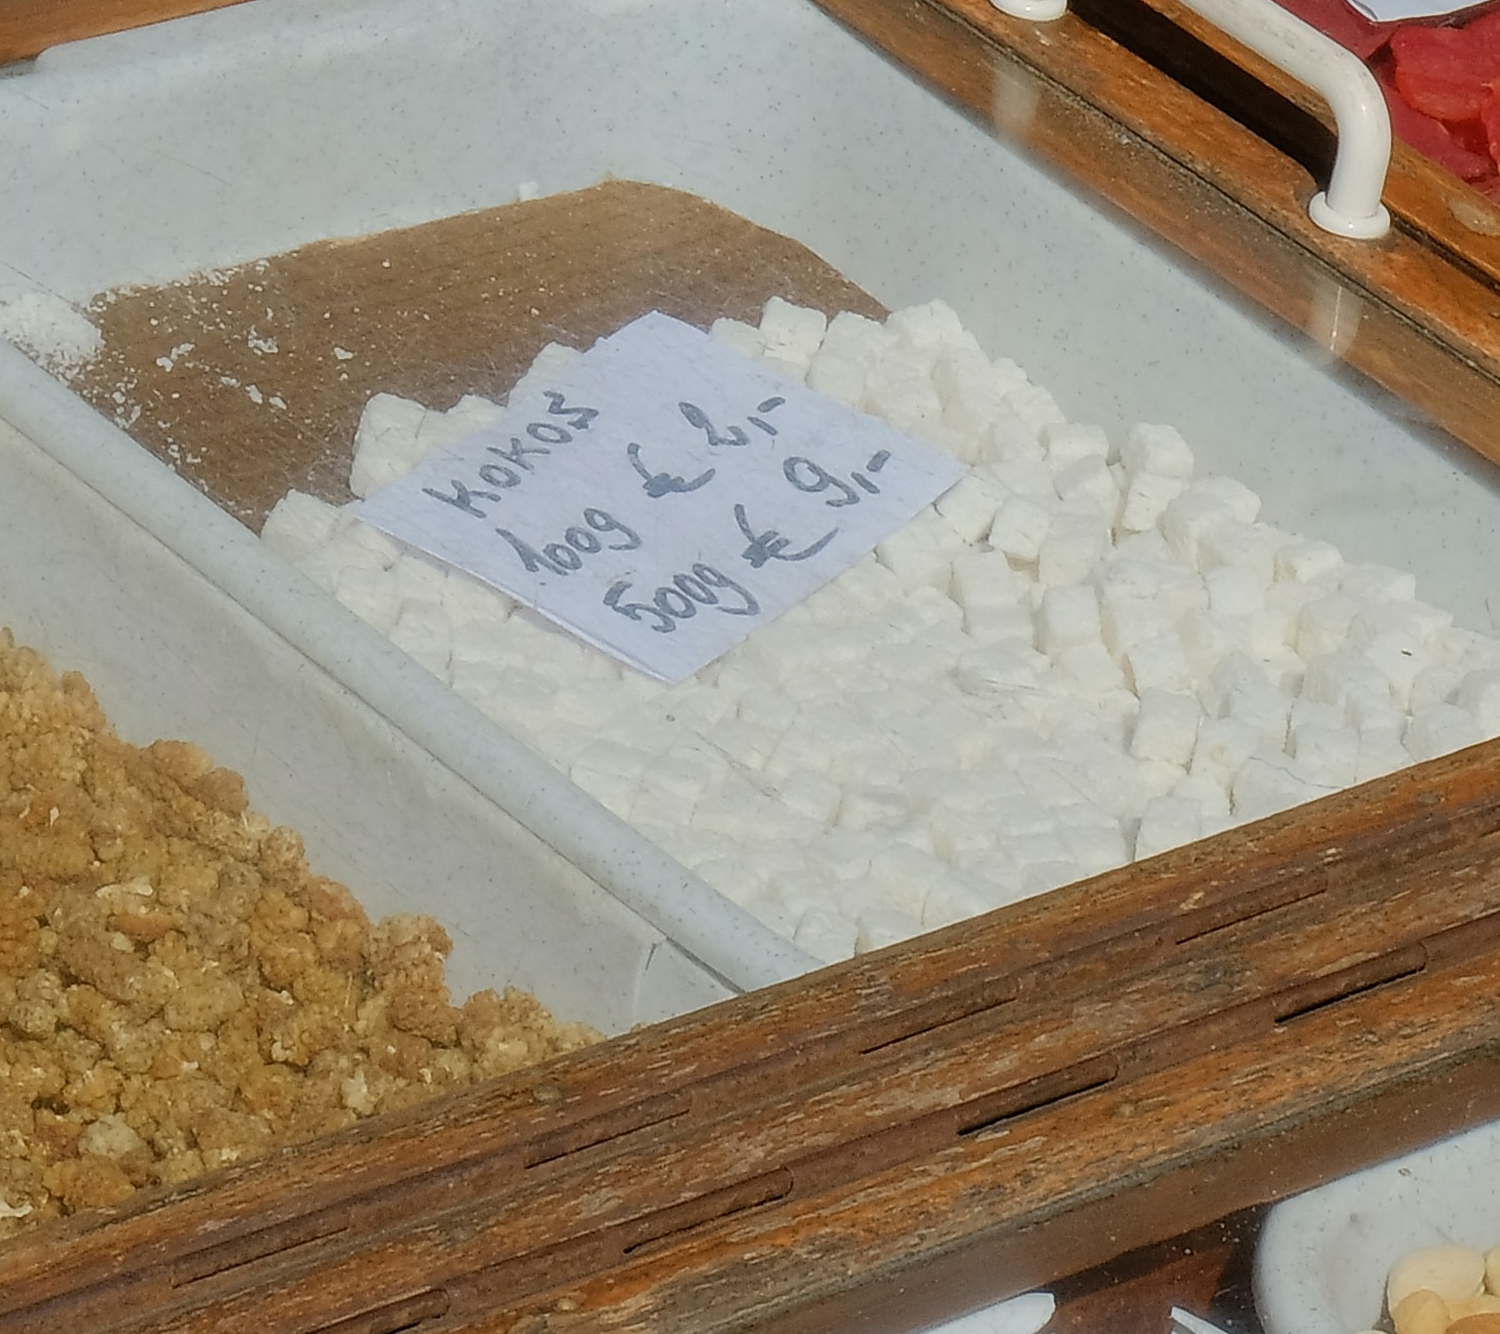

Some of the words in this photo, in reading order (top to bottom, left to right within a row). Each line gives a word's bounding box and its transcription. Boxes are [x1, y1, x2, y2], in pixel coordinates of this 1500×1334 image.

[421, 389, 599, 519] KOKOS
[496, 505, 642, 578] 100g
[626, 441, 716, 499] €
[603, 561, 760, 635] 500g
[733, 503, 840, 569] €
